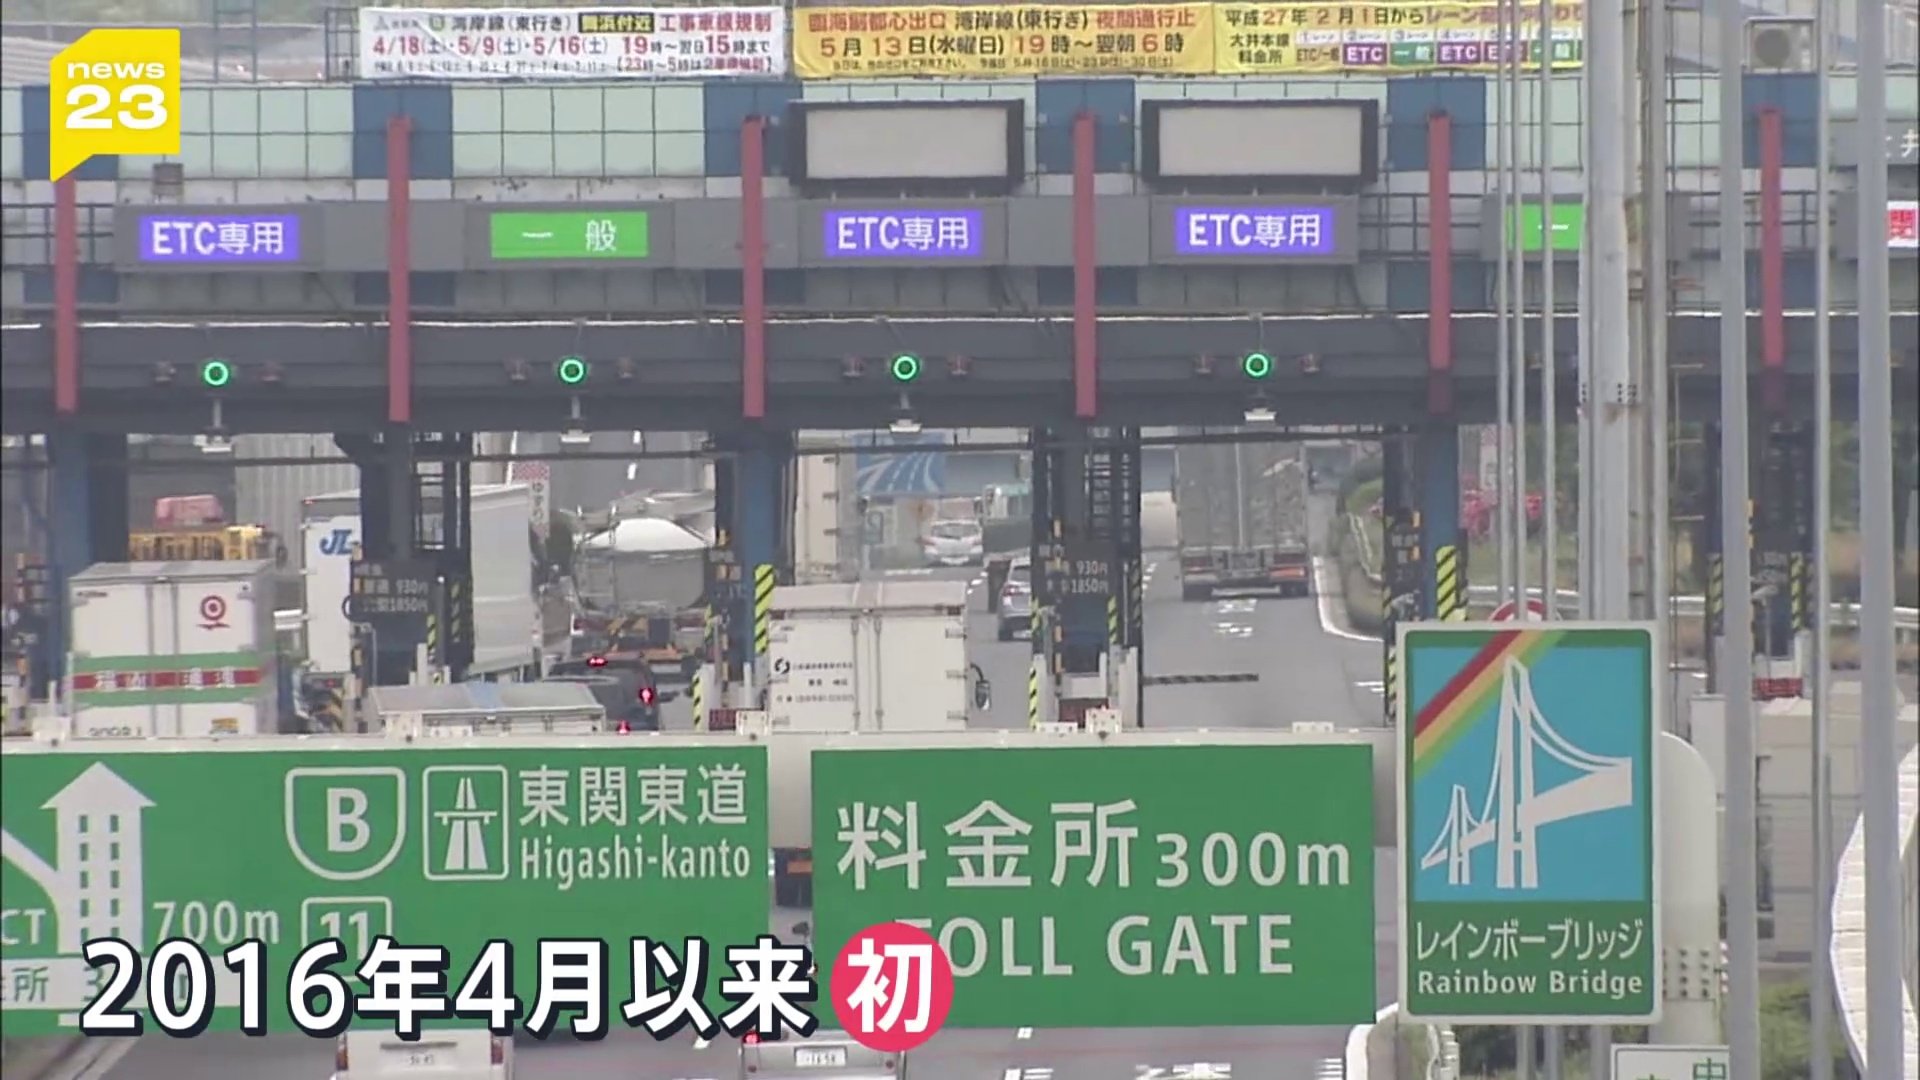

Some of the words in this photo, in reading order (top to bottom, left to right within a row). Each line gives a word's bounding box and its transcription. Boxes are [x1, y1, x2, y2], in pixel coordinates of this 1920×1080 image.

[1347, 46, 1383, 62] ETC
[1441, 45, 1477, 61] ETC
[152, 221, 284, 255] ETC専用
[521, 219, 617, 253] 一般
[837, 215, 969, 251] ETC専用
[1189, 213, 1320, 248] ETC専用
[519, 766, 748, 826] 東関東道
[326, 787, 371, 853] B
[837, 799, 1139, 890] 料金所
[1155, 832, 1350, 888] 300m
[520, 838, 751, 890] Higashi-kanto
[153, 900, 279, 944] 700m
[1416, 921, 1643, 961] レインボーブリッジ
[1106, 915, 1293, 975] GATE
[1418, 971, 1537, 995] Rainbow
[1550, 970, 1643, 999] Bridge
